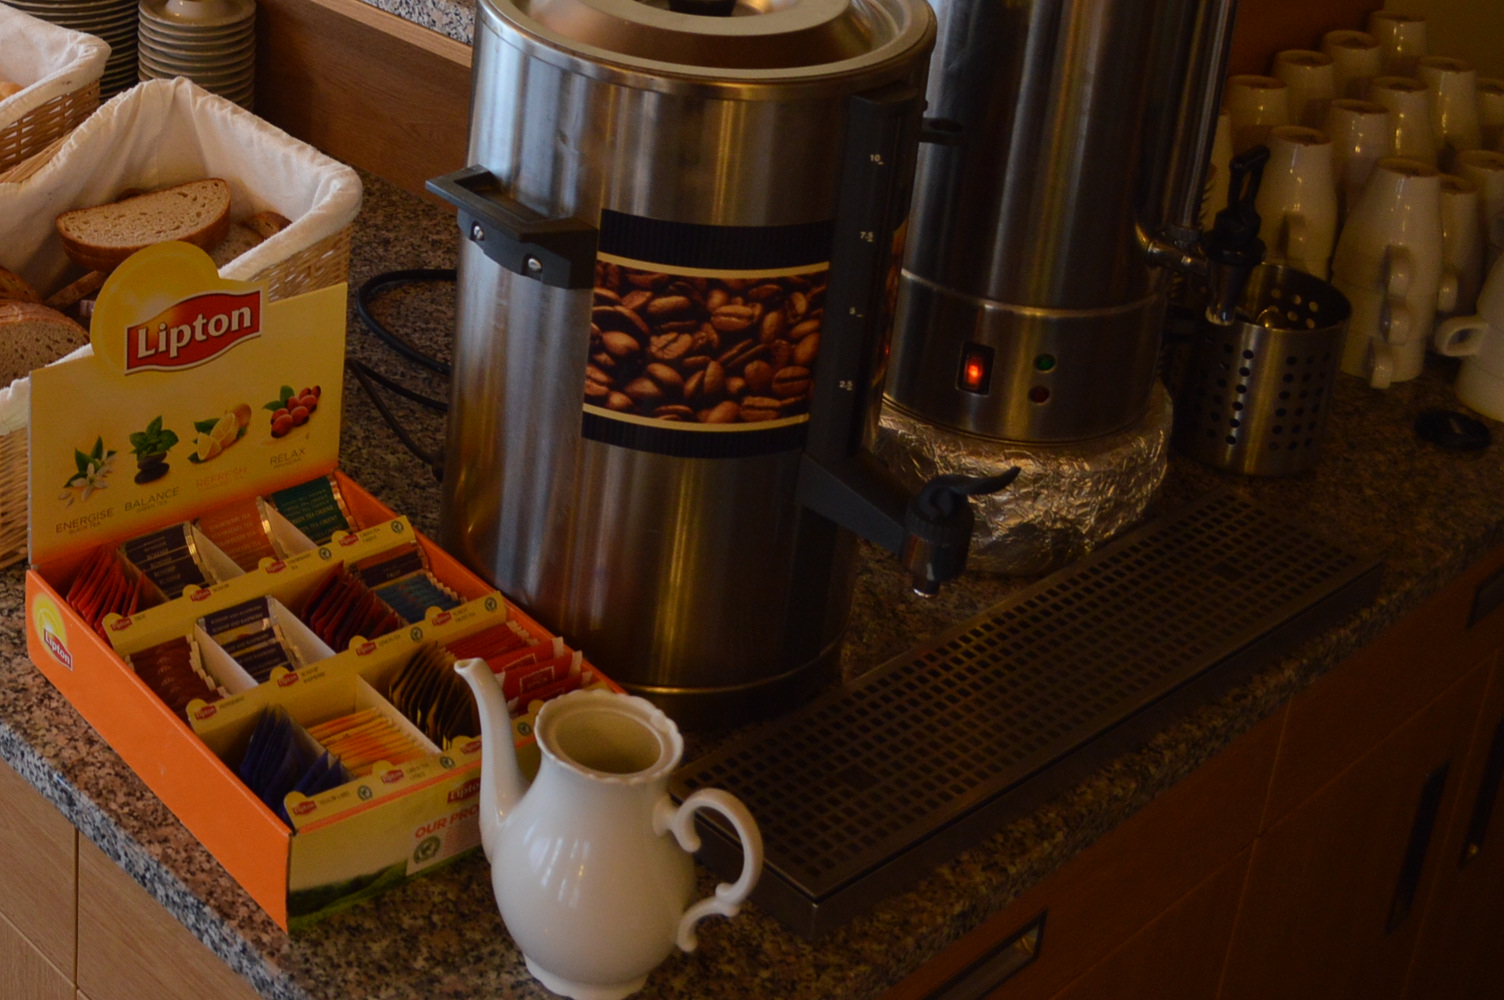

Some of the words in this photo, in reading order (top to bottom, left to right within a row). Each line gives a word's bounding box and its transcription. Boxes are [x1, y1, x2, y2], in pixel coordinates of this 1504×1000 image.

[869, 153, 881, 163] 10
[136, 305, 252, 359] Lipton
[269, 447, 306, 466] RELAX
[196, 466, 247, 489] REFRESH
[124, 486, 179, 512] BALANCE
[55, 507, 115, 534] ENERGISE
[45, 632, 71, 665] Lipton
[195, 706, 216, 720] Lipton
[381, 770, 404, 783] Lipton
[450, 782, 479, 800] Lipto
[293, 802, 317, 815] Lipton
[415, 817, 447, 838] OUR
[449, 805, 479, 825] PRO
